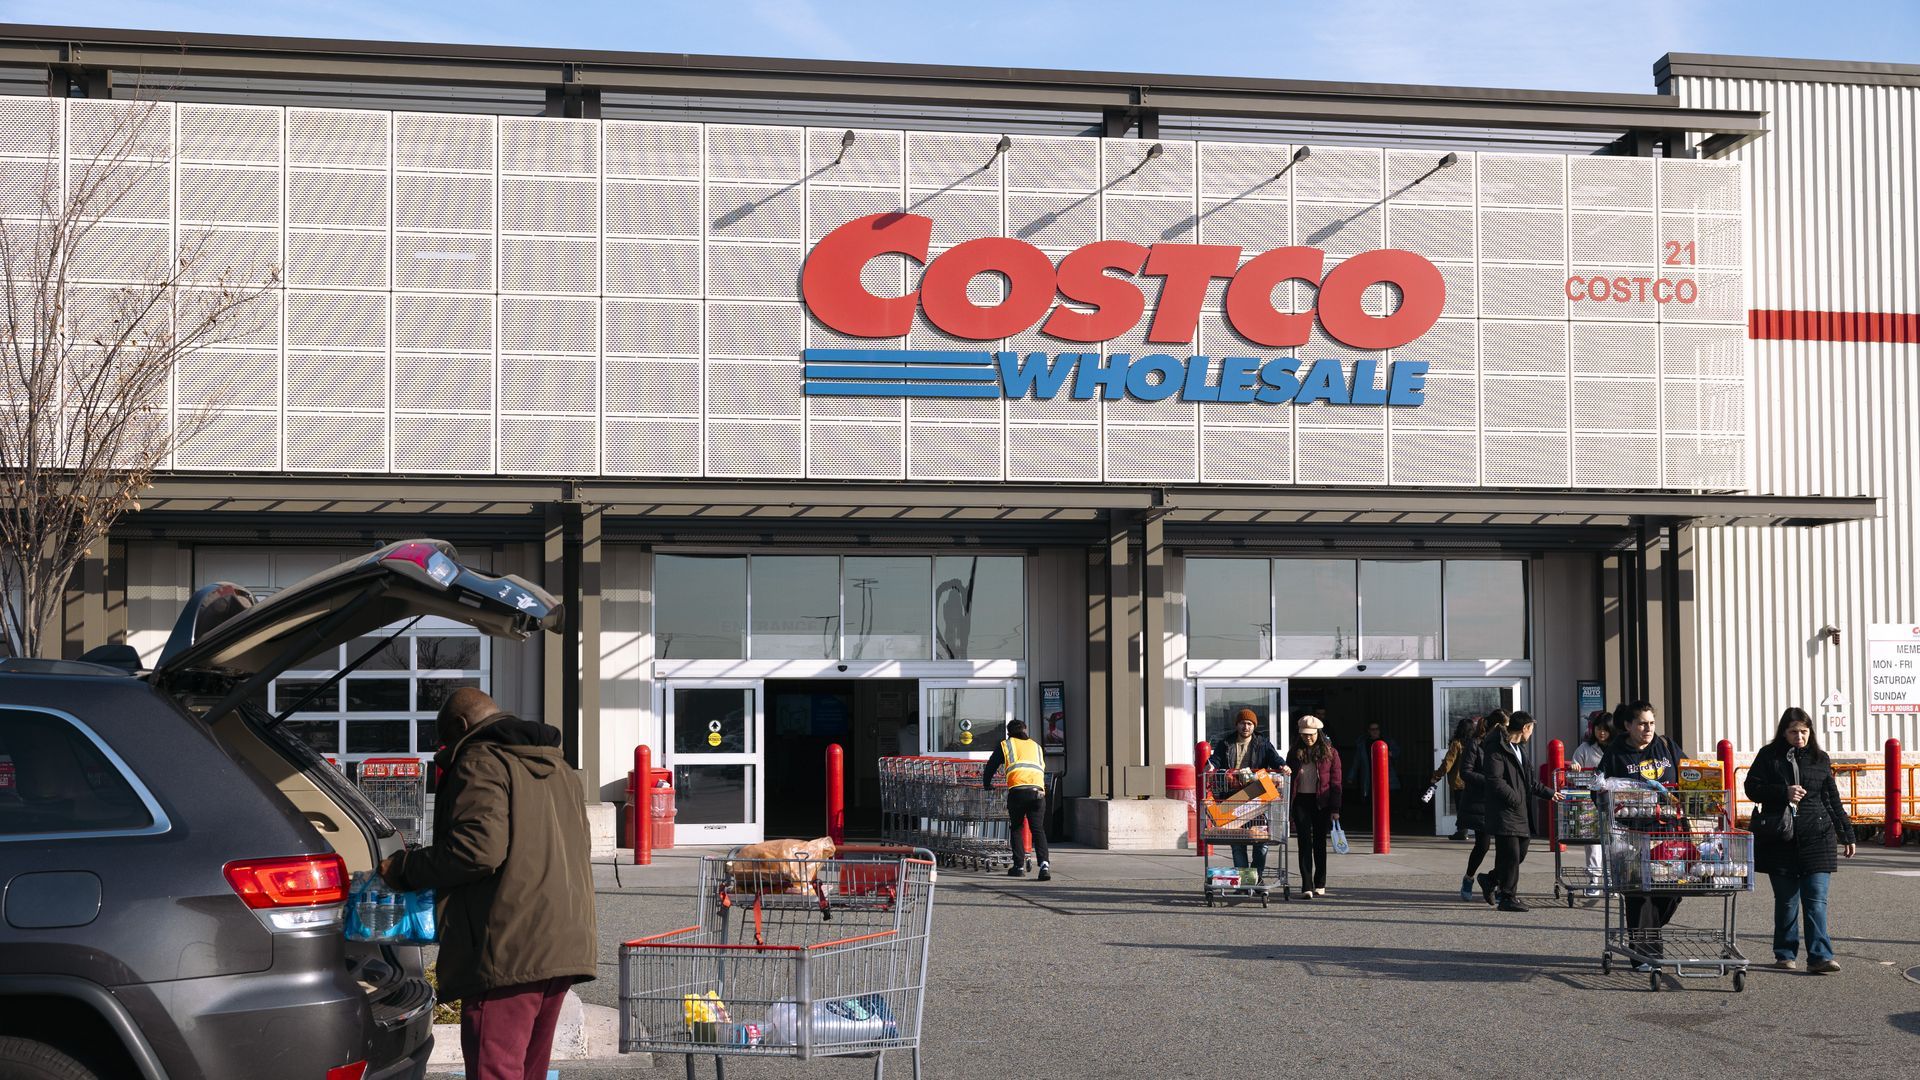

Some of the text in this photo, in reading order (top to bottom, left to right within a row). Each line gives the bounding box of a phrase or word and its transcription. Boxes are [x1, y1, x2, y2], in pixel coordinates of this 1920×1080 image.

[1665, 240, 1695, 265] 21
[802, 212, 1446, 351] COSTCO
[1565, 275, 1698, 304] COSTCO
[996, 351, 1429, 407] WHOLESALE
[720, 619, 817, 632] ENRANCE
[1872, 660, 1893, 669] MON
[1899, 660, 1913, 669] FRI
[1873, 676, 1916, 685] SATURDAY
[1873, 692, 1907, 700] SUNDAY
[1829, 716, 1847, 727] FDC
